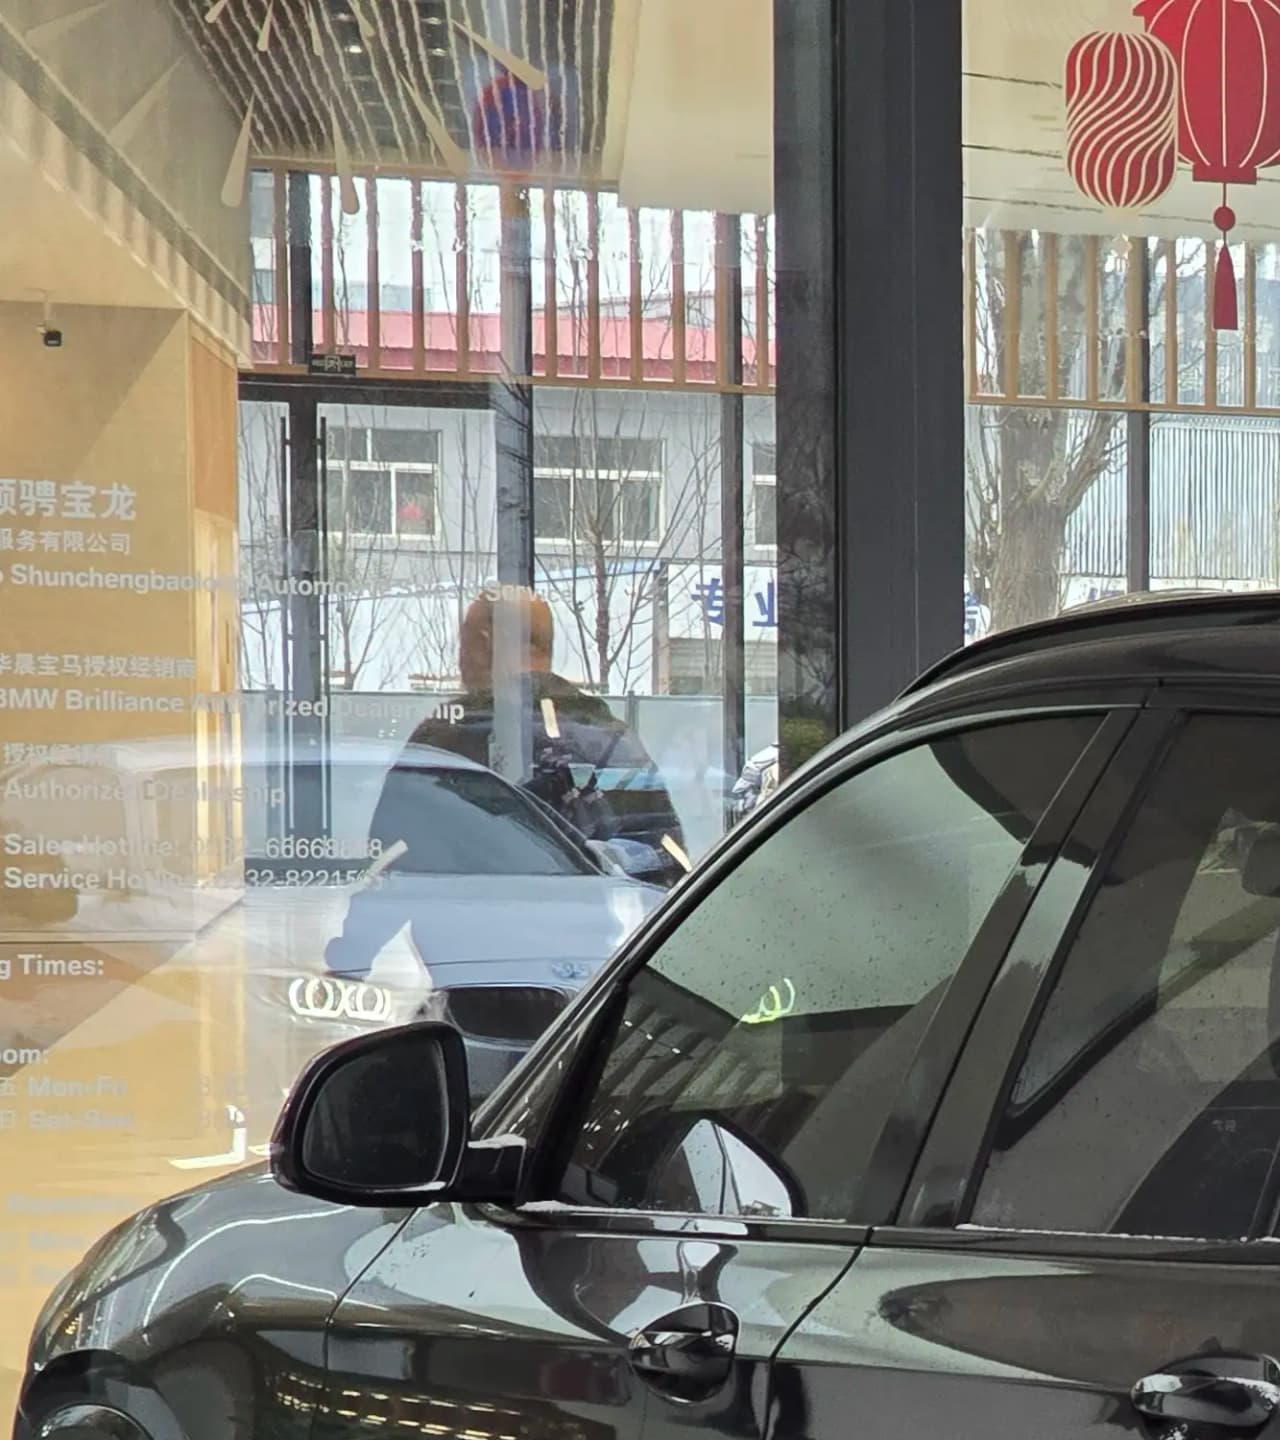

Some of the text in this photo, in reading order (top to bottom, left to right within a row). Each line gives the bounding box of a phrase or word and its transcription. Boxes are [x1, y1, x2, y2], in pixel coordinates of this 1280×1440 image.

[10, 563, 248, 597] Shunchengbaolo
[256, 572, 391, 597] Automo
[65, 689, 184, 713] Brilliance
[4, 779, 139, 801] Authorize
[4, 867, 99, 890] Service
[18, 954, 104, 976] Times:
